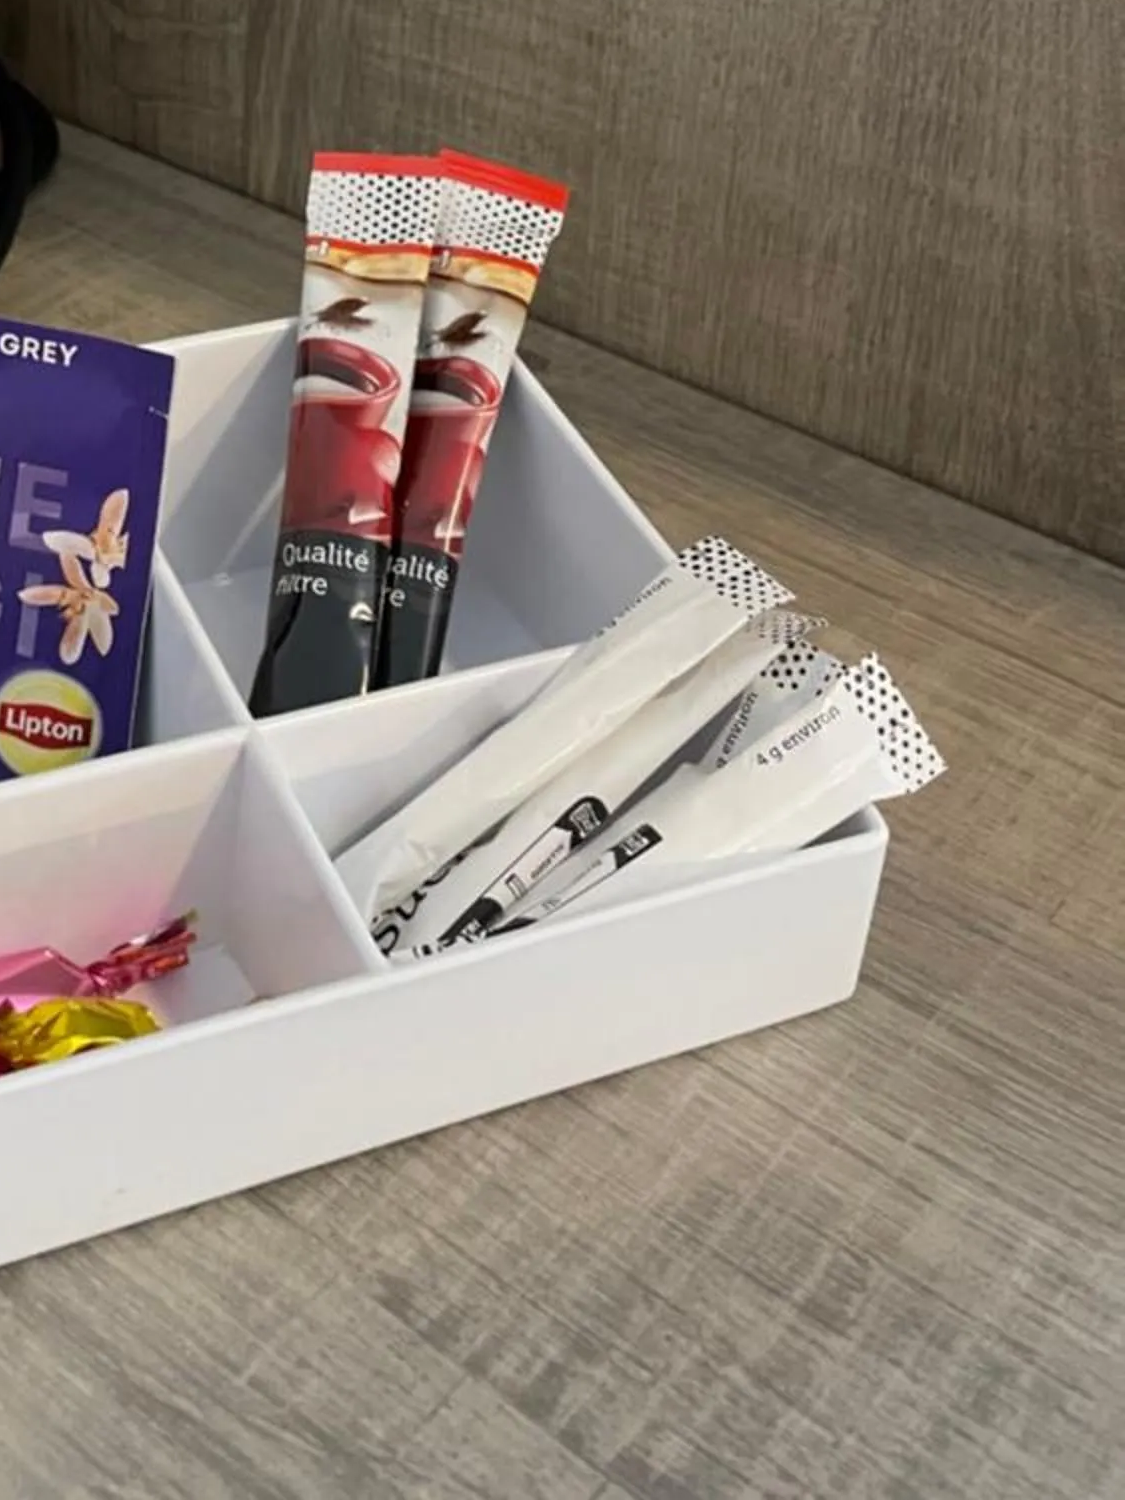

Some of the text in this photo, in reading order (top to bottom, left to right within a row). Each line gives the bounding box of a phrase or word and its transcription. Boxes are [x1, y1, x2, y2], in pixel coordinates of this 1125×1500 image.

[281, 541, 371, 574] Qualité
[4, 707, 85, 743] Lipton
[721, 691, 759, 755] environ
[756, 705, 842, 767] 4 g environ
